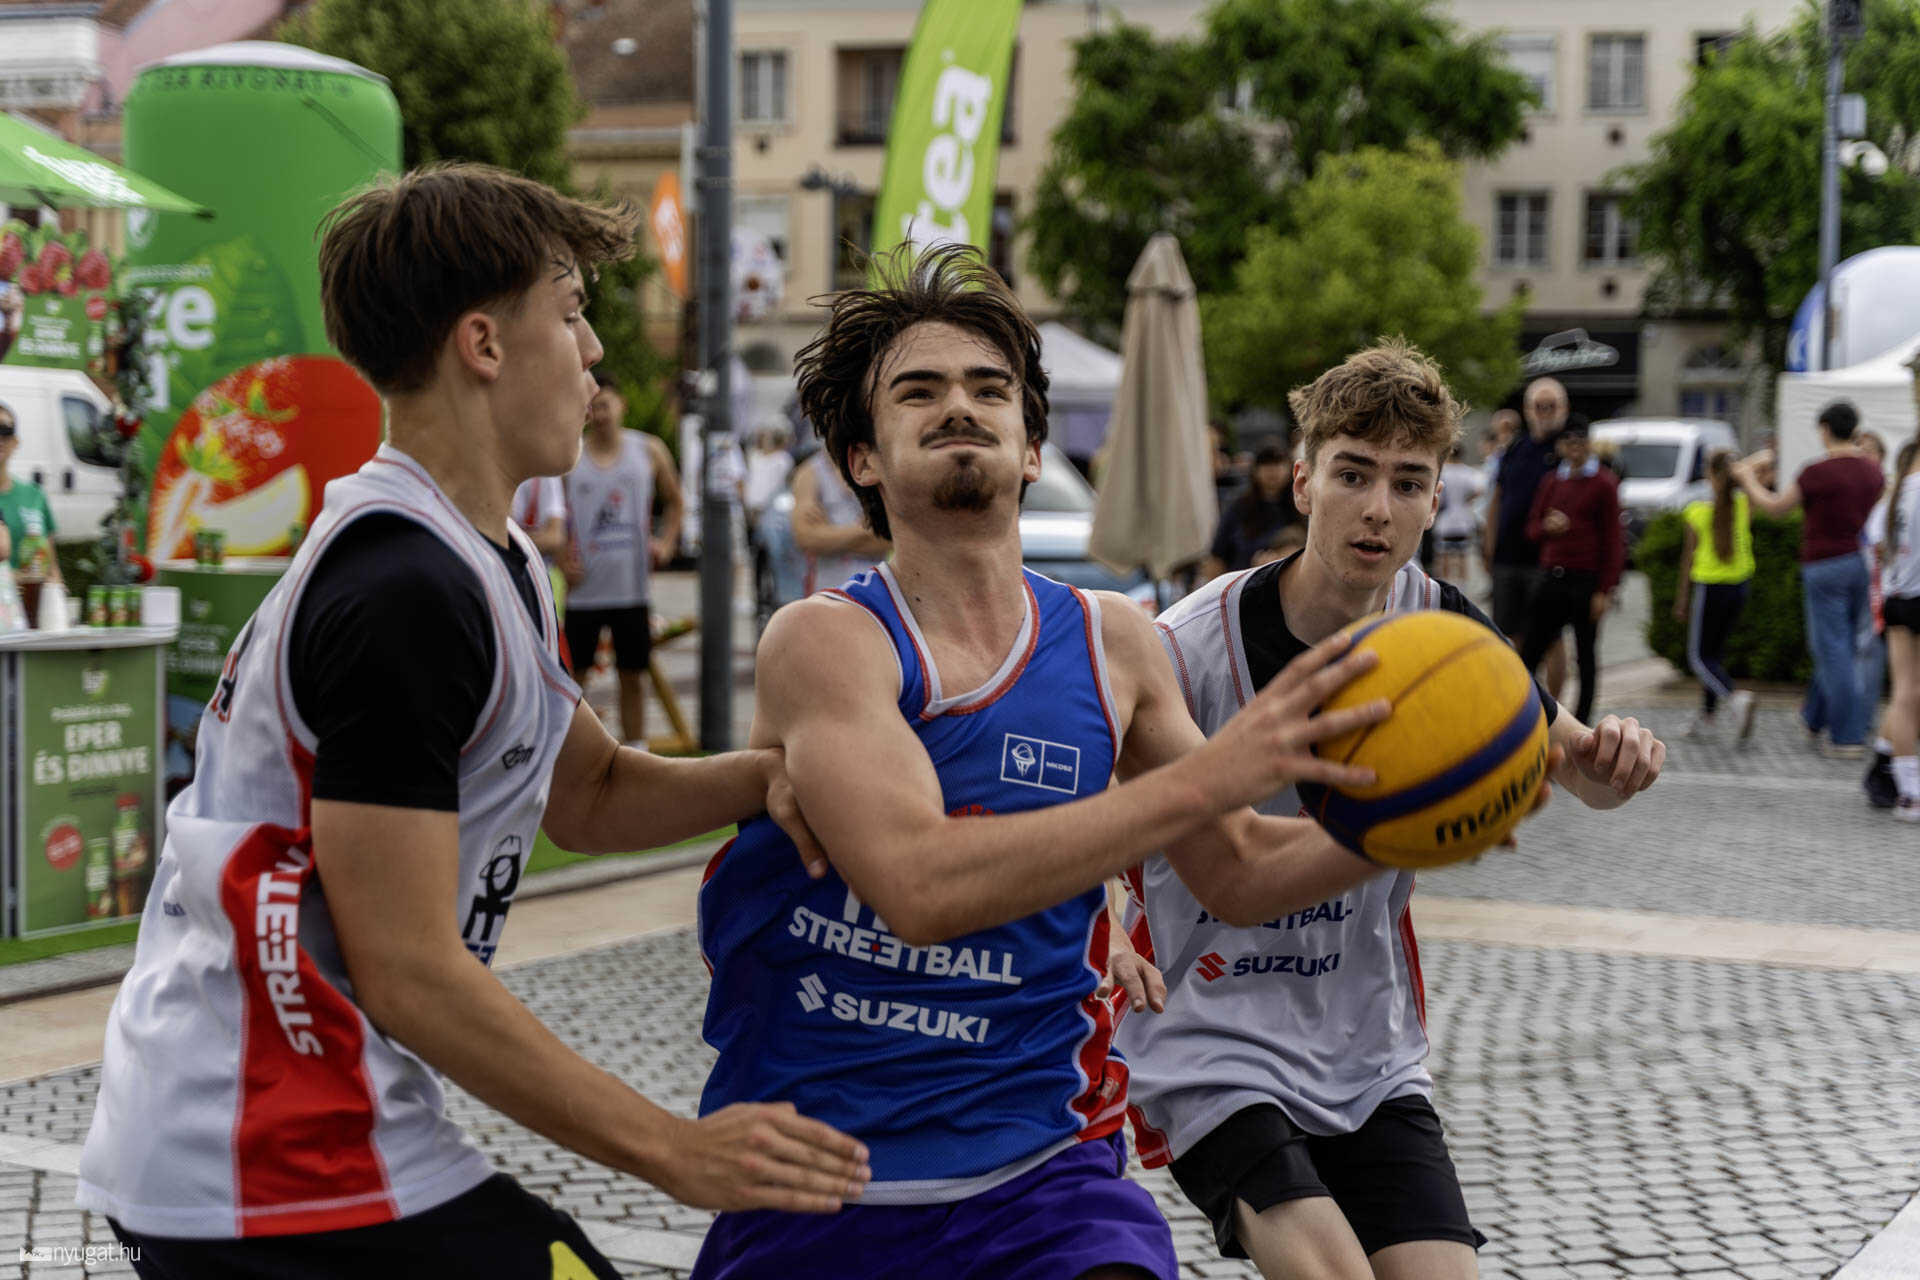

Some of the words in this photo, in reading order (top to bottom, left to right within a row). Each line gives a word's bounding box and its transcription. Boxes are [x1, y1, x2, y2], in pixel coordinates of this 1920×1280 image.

[64, 720, 122, 752] EPER
[33, 750, 64, 785] ÉS
[1436, 744, 1546, 845] molten
[788, 905, 1023, 985] STREETBALL
[1232, 953, 1340, 977] SUZUKI
[831, 992, 990, 1043] SUZUKI
